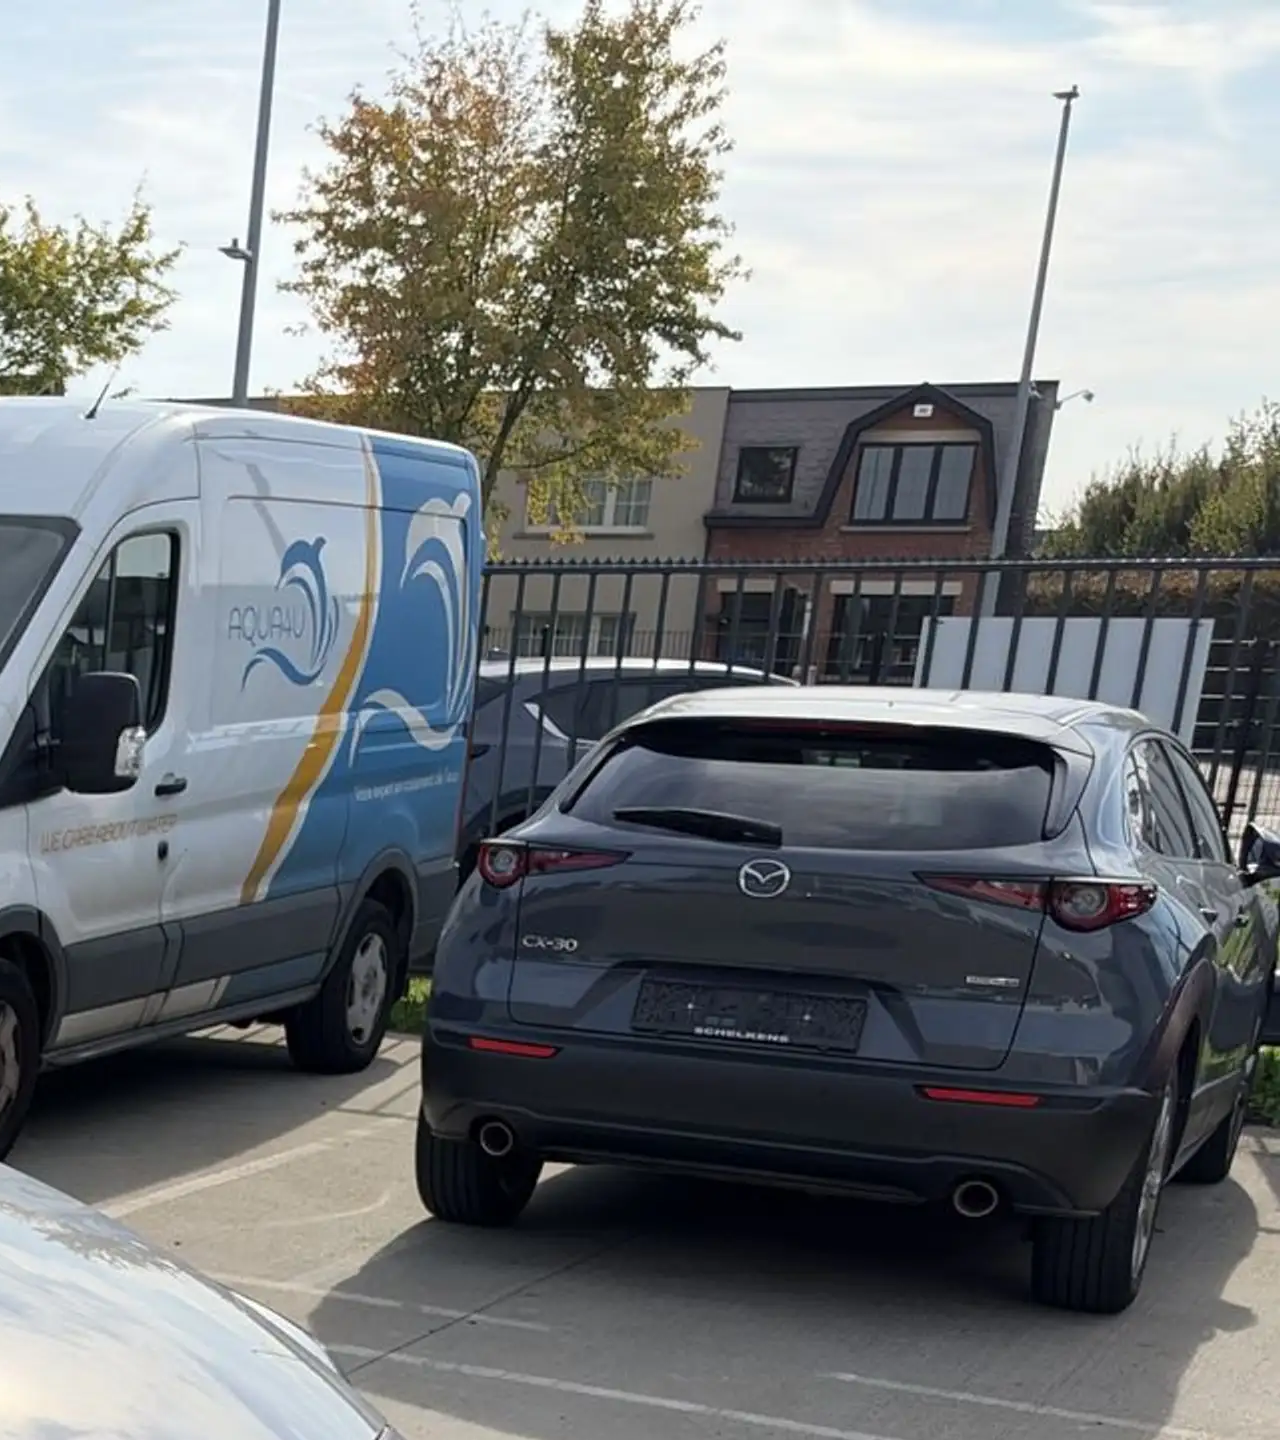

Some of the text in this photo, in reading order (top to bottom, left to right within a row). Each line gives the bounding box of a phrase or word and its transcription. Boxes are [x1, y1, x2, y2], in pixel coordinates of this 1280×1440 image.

[228, 605, 305, 647] AQUA4U
[522, 934, 578, 952] CX-30
[693, 1026, 789, 1044] SCHELKENS
